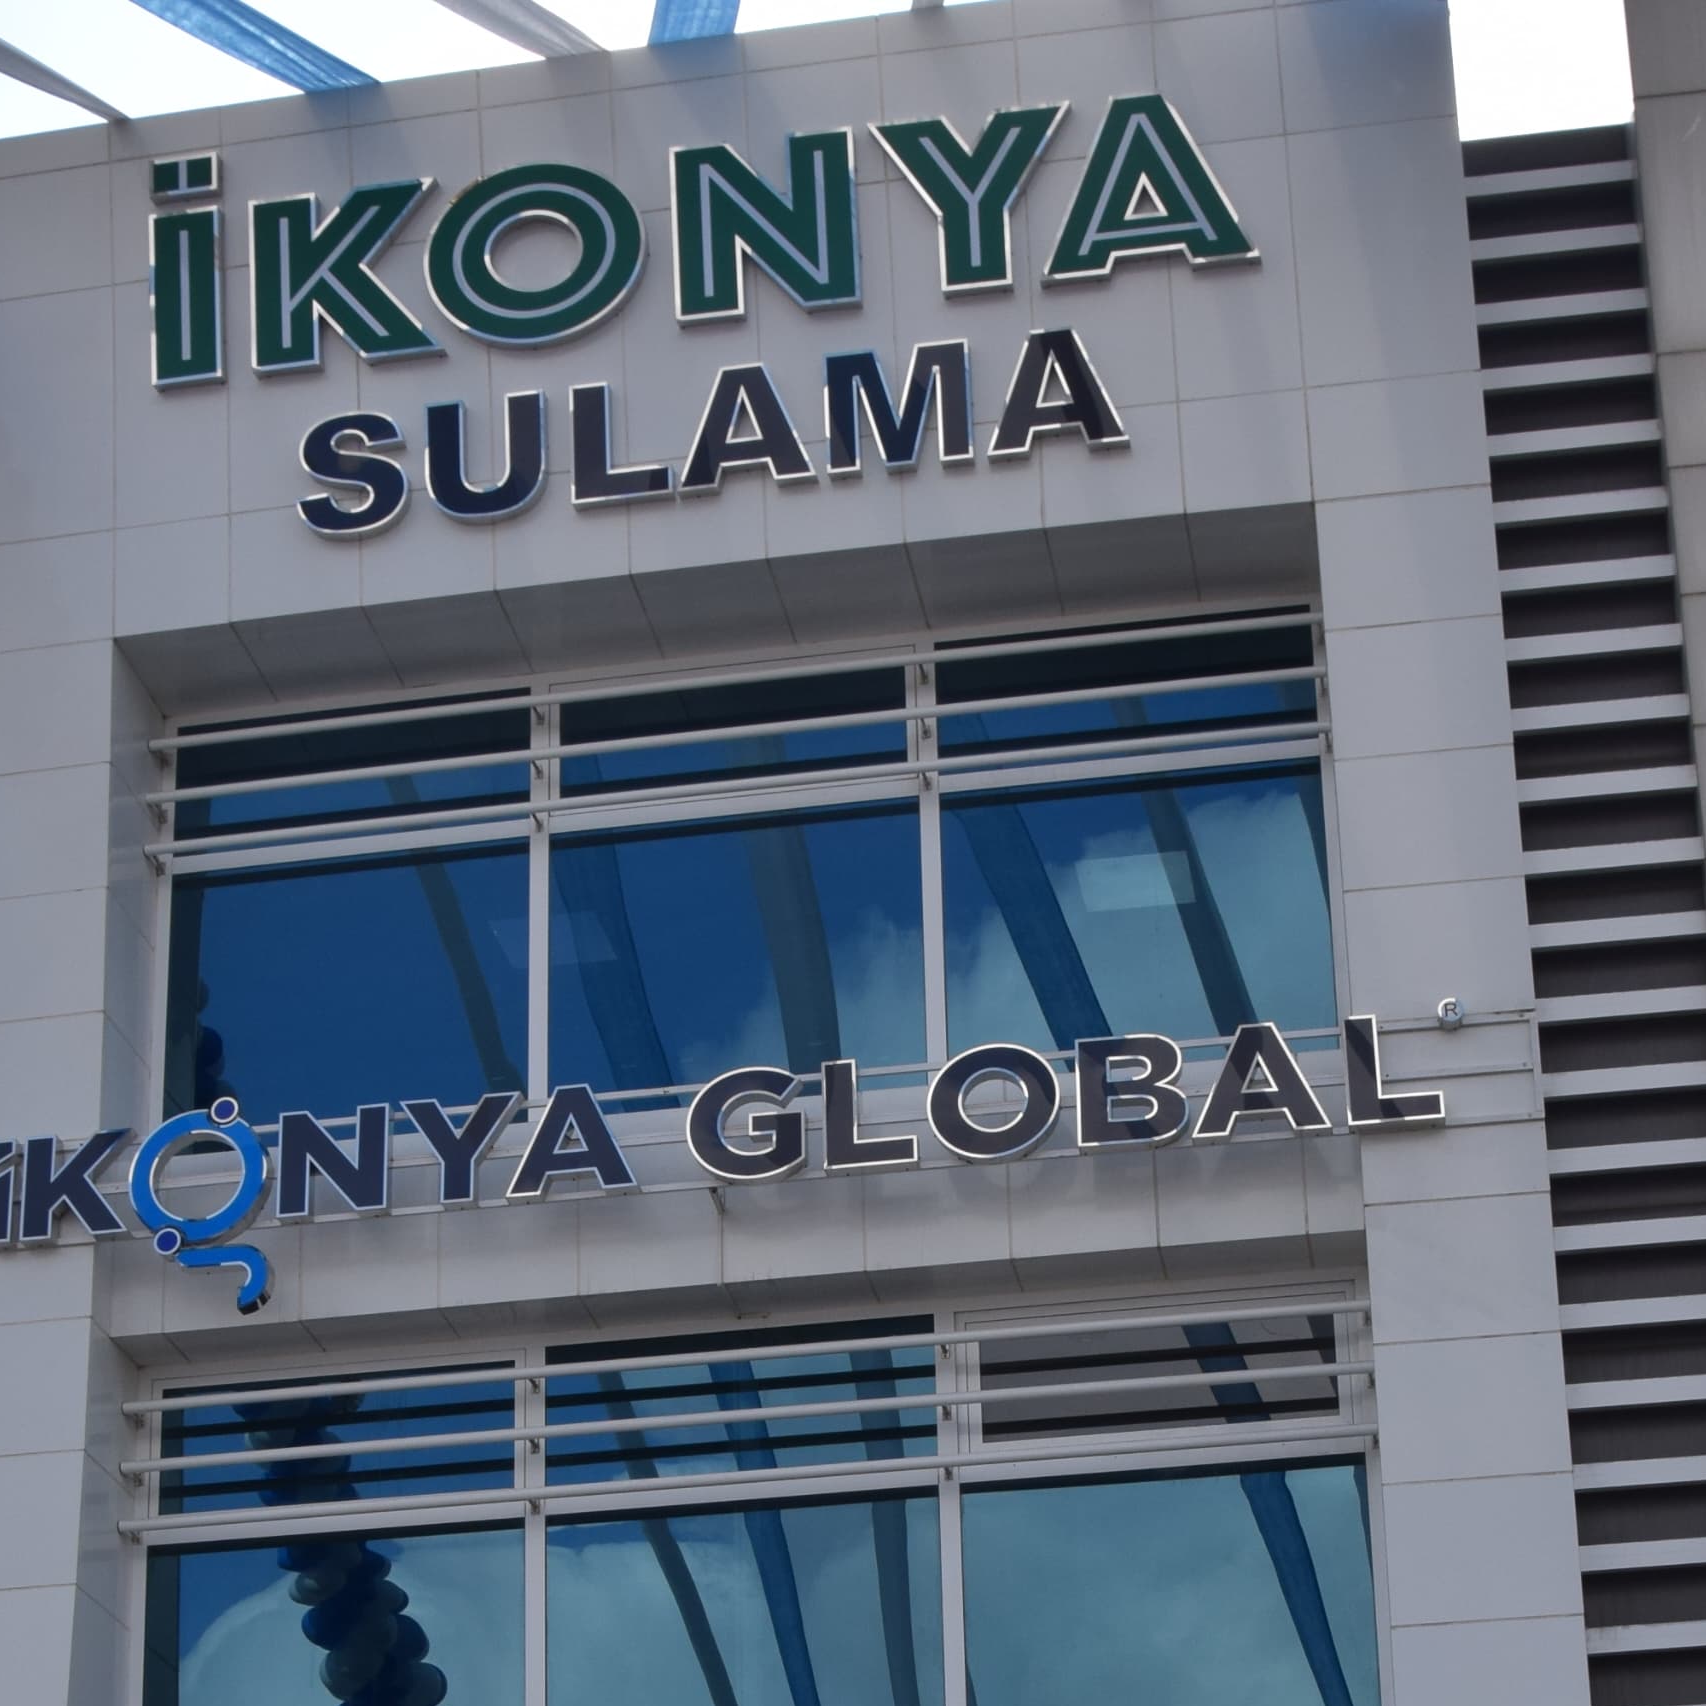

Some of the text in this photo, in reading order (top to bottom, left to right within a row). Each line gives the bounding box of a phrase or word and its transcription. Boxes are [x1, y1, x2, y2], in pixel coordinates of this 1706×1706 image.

[150, 94, 1260, 390] İKONYA
[297, 329, 1131, 540] SULAMA
[684, 1014, 1446, 1183] GLOBAL
